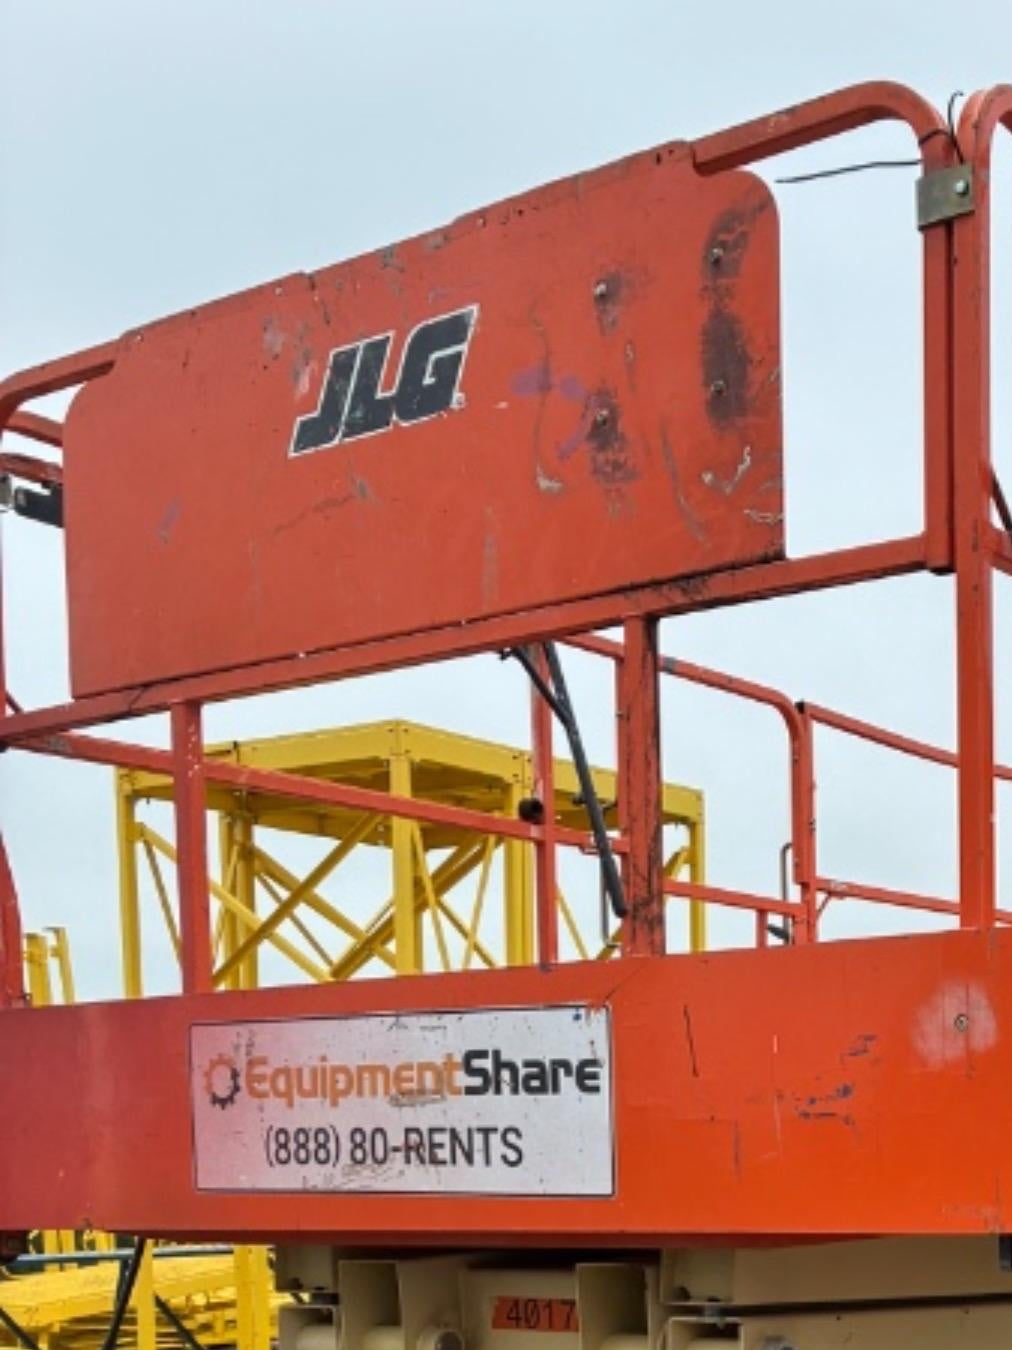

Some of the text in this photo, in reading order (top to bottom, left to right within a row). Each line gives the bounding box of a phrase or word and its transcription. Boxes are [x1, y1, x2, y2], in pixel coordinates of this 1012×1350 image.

[288, 303, 480, 459] JLG
[245, 1049, 602, 1107] EquipmentShare
[265, 1124, 524, 1168] (888) 80-RENTS
